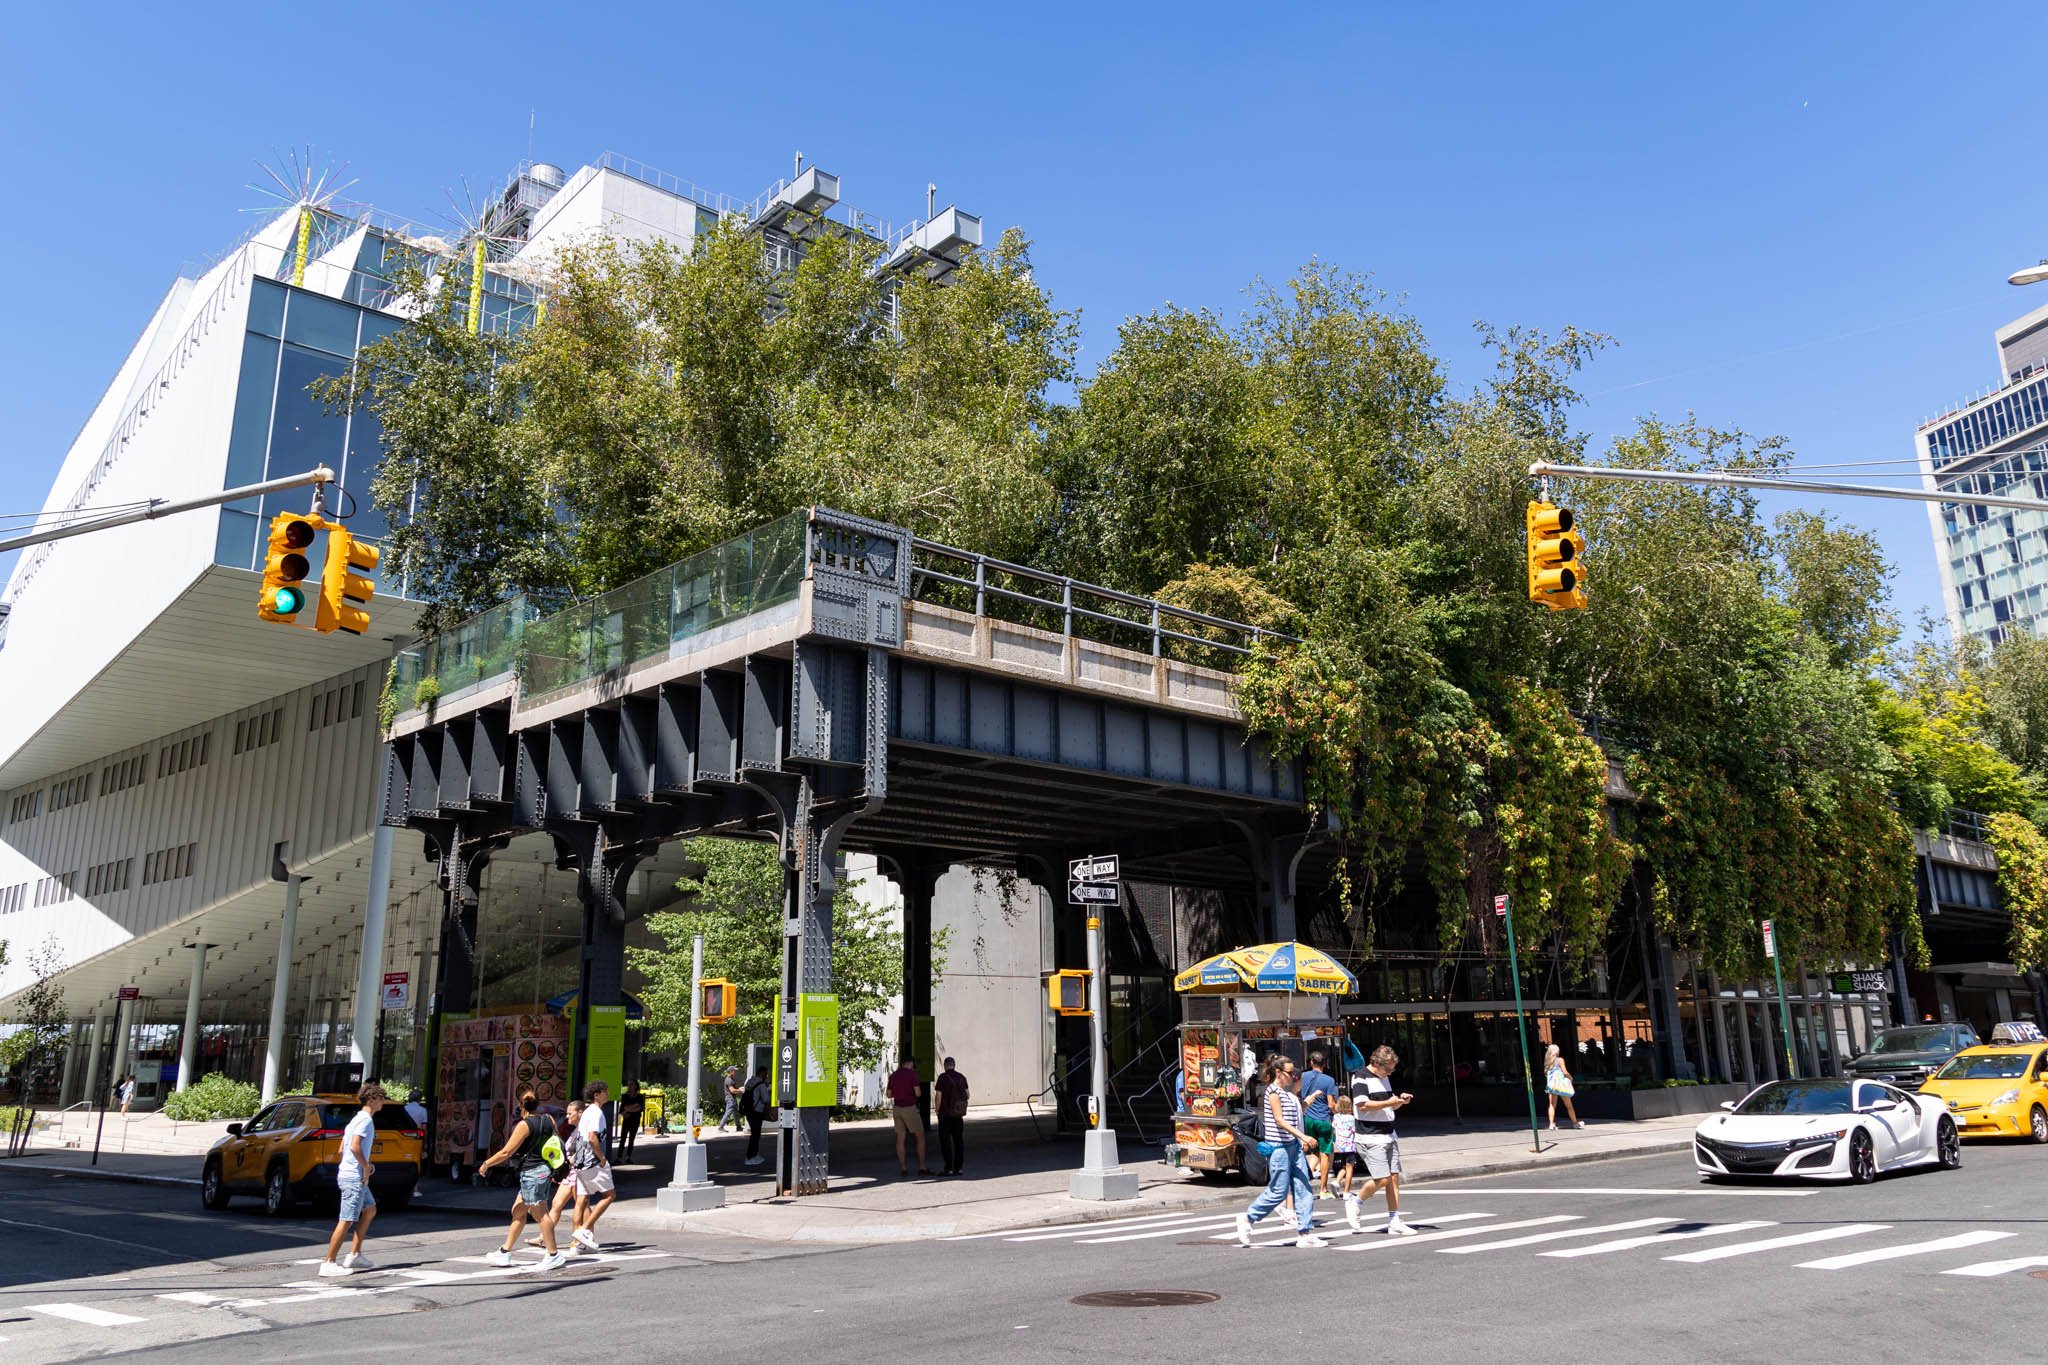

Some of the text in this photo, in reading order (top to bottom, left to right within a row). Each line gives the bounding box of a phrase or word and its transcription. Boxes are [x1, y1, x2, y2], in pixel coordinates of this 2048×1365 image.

[1076, 863, 1112, 876] ONE WAY
[1076, 887, 1112, 898] ONE WAY
[1852, 972, 1884, 982] SHAKE
[1299, 978, 1344, 990] SABRETT
[1853, 981, 1887, 991] SHACK
